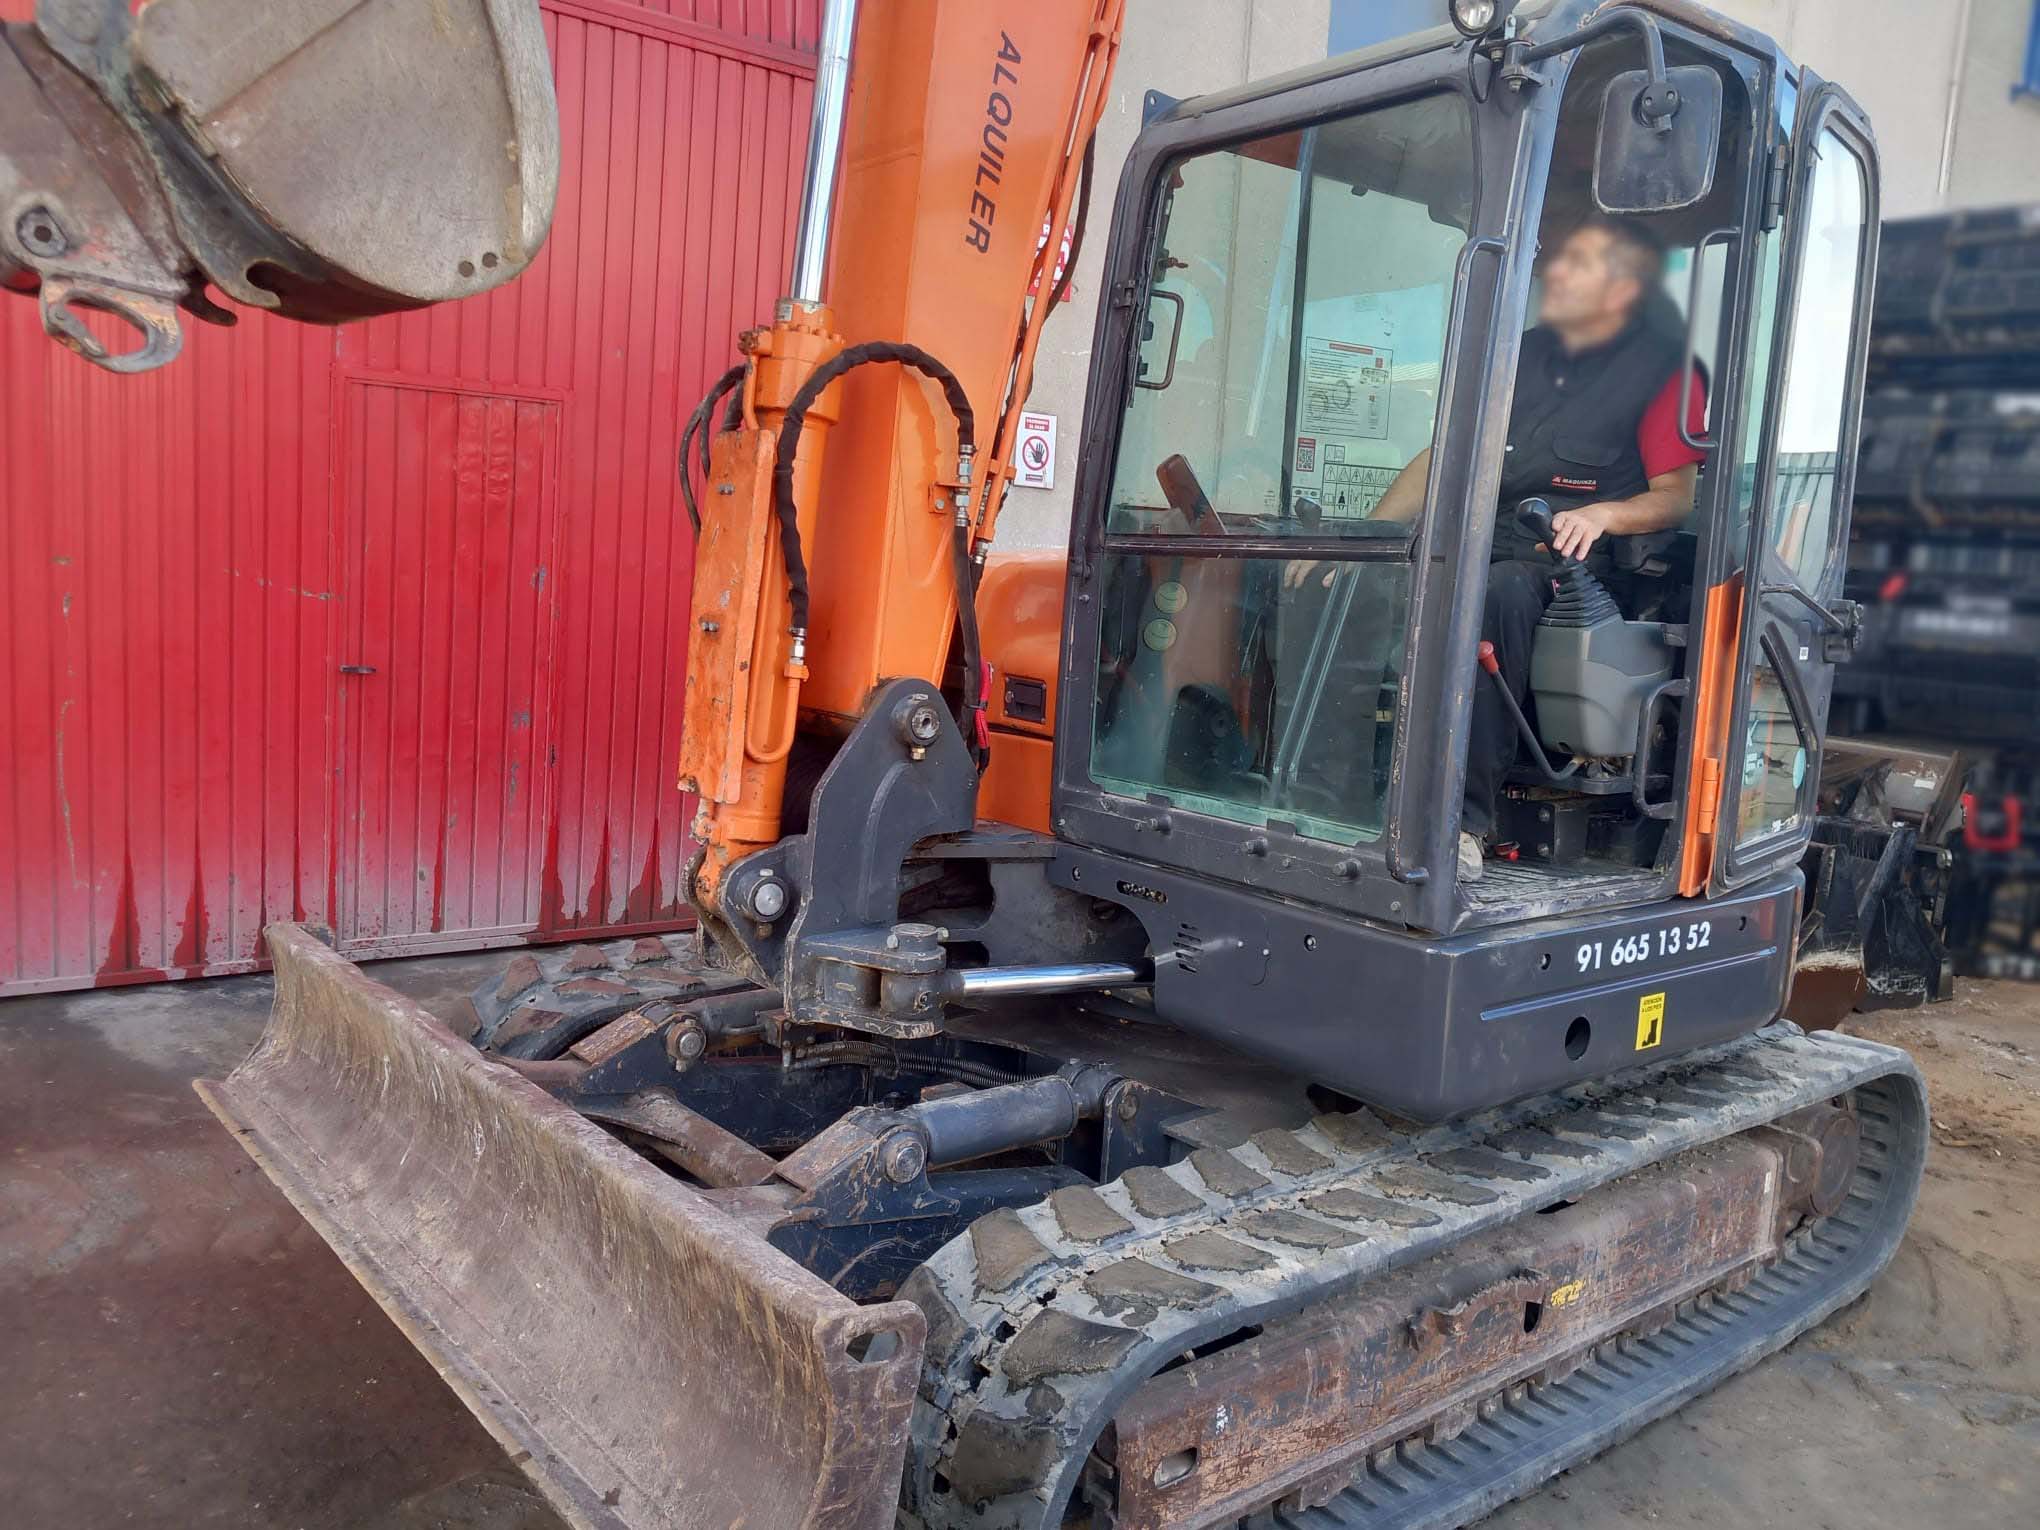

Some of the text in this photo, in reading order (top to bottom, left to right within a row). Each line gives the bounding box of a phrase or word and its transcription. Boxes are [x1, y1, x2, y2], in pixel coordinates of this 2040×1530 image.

[965, 31, 1022, 254] ALQUILER
[1577, 920, 1711, 972] 91 665 13 52
